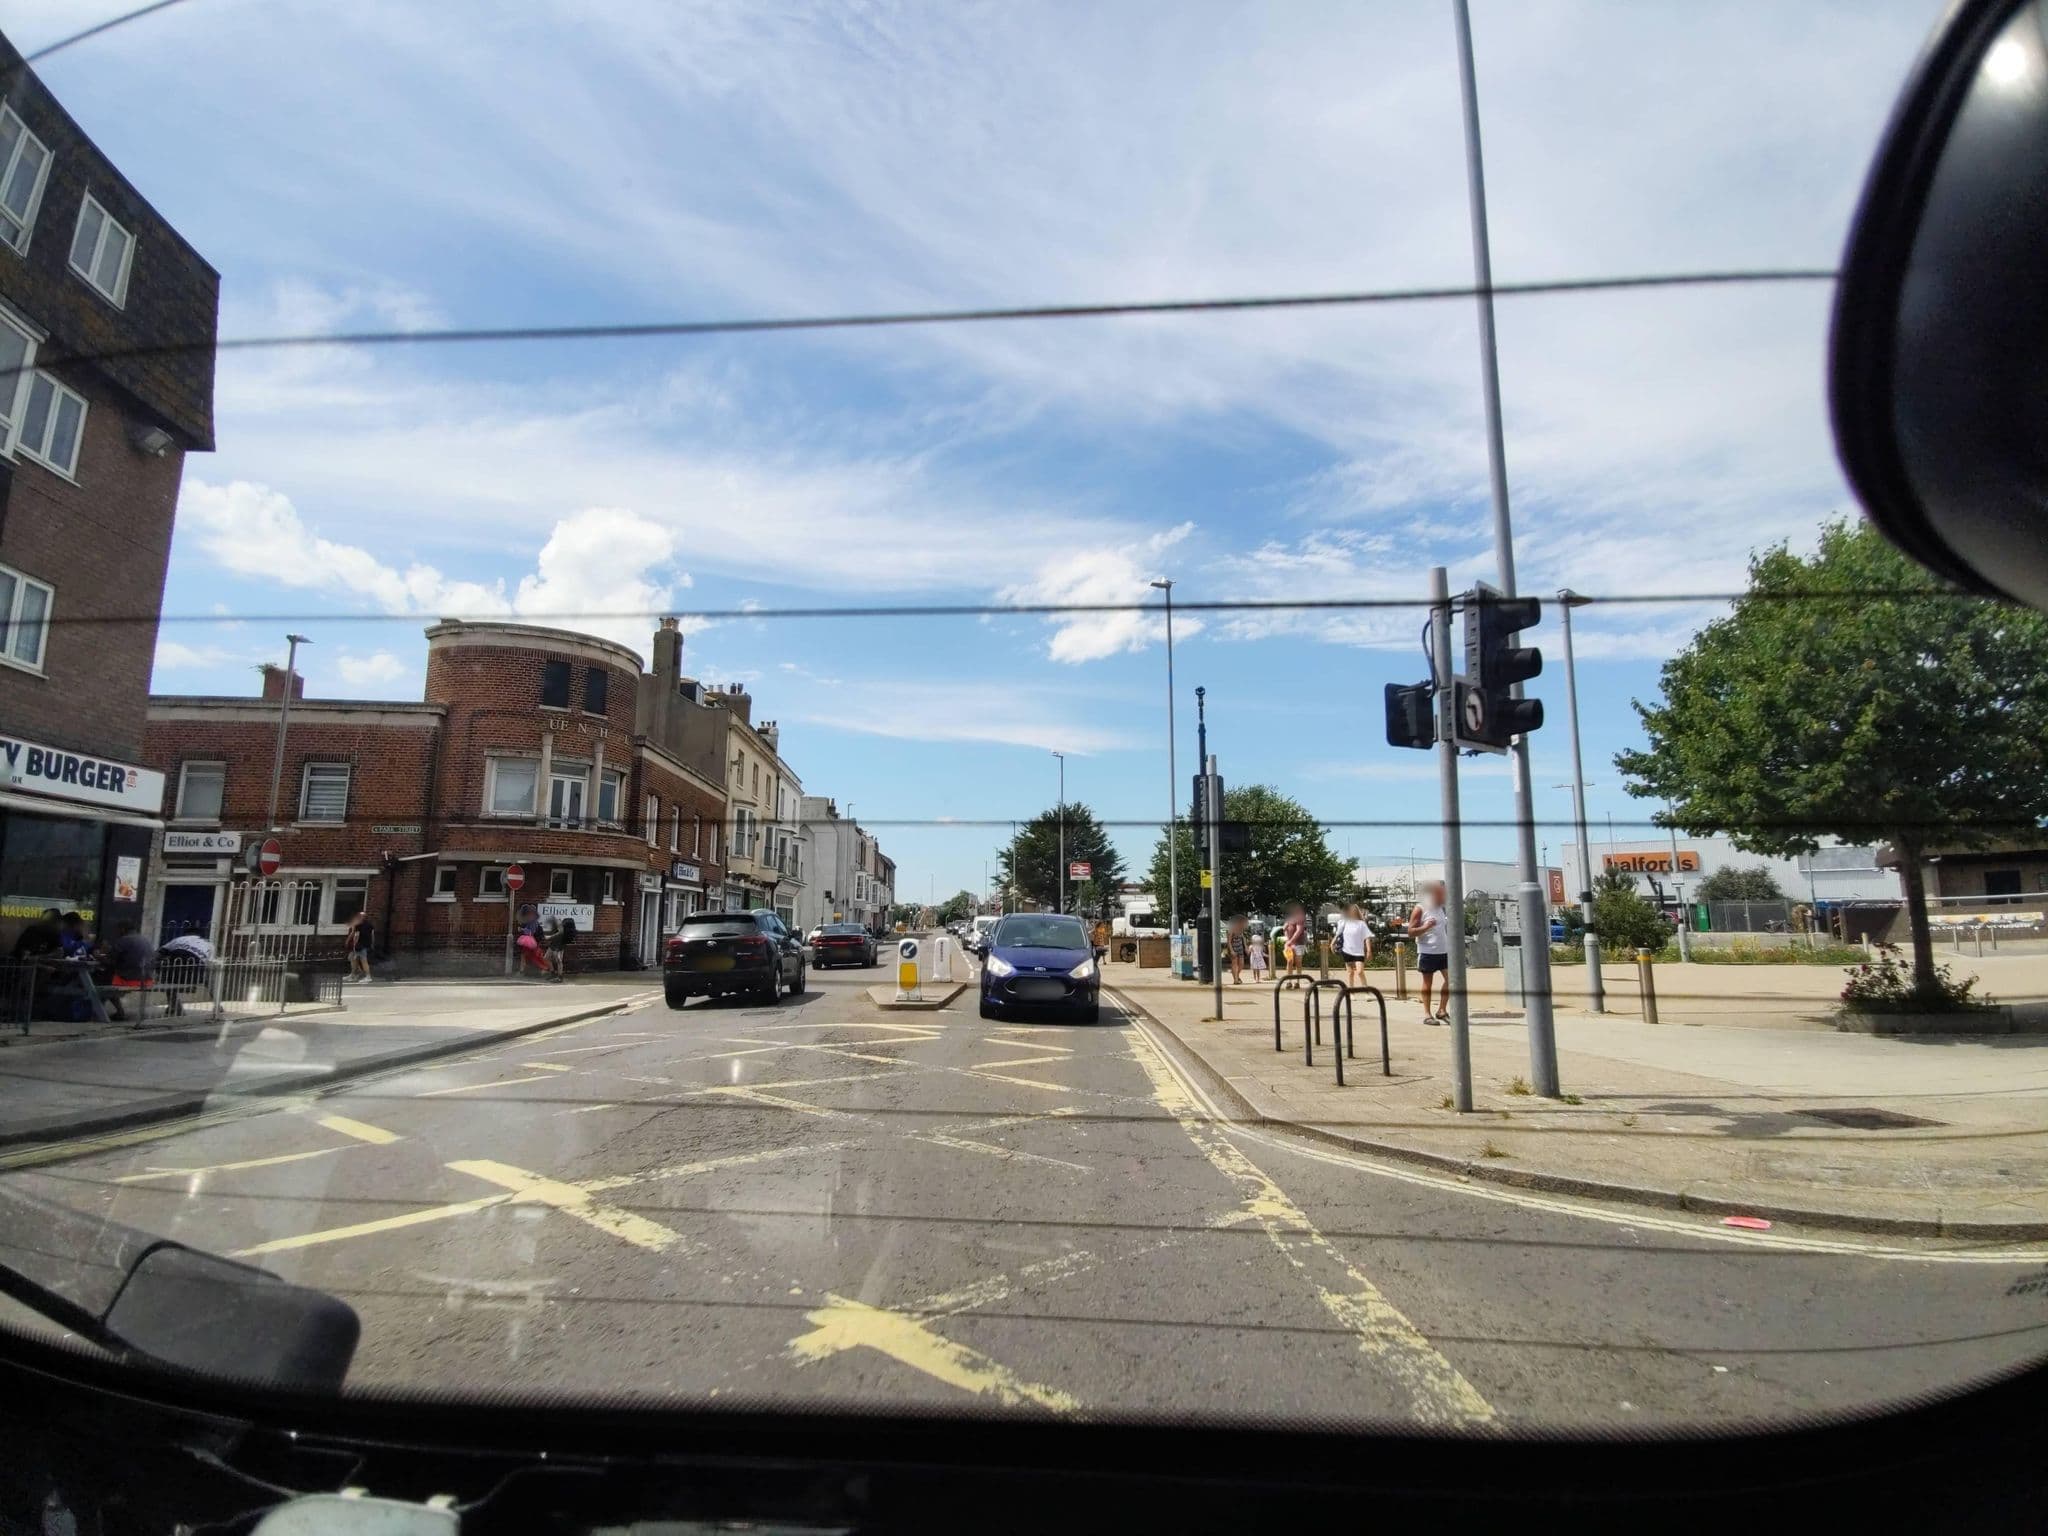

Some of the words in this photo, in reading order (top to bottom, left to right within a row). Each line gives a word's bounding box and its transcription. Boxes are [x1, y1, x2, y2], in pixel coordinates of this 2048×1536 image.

[26, 747, 126, 793] BURGER
[168, 836, 200, 848] Elliot
[202, 836, 214, 848] &
[217, 836, 234, 848] Co
[1, 905, 44, 919] NAUGHT
[542, 906, 568, 916] Elliot
[571, 907, 579, 916] &
[581, 907, 592, 917] Co
